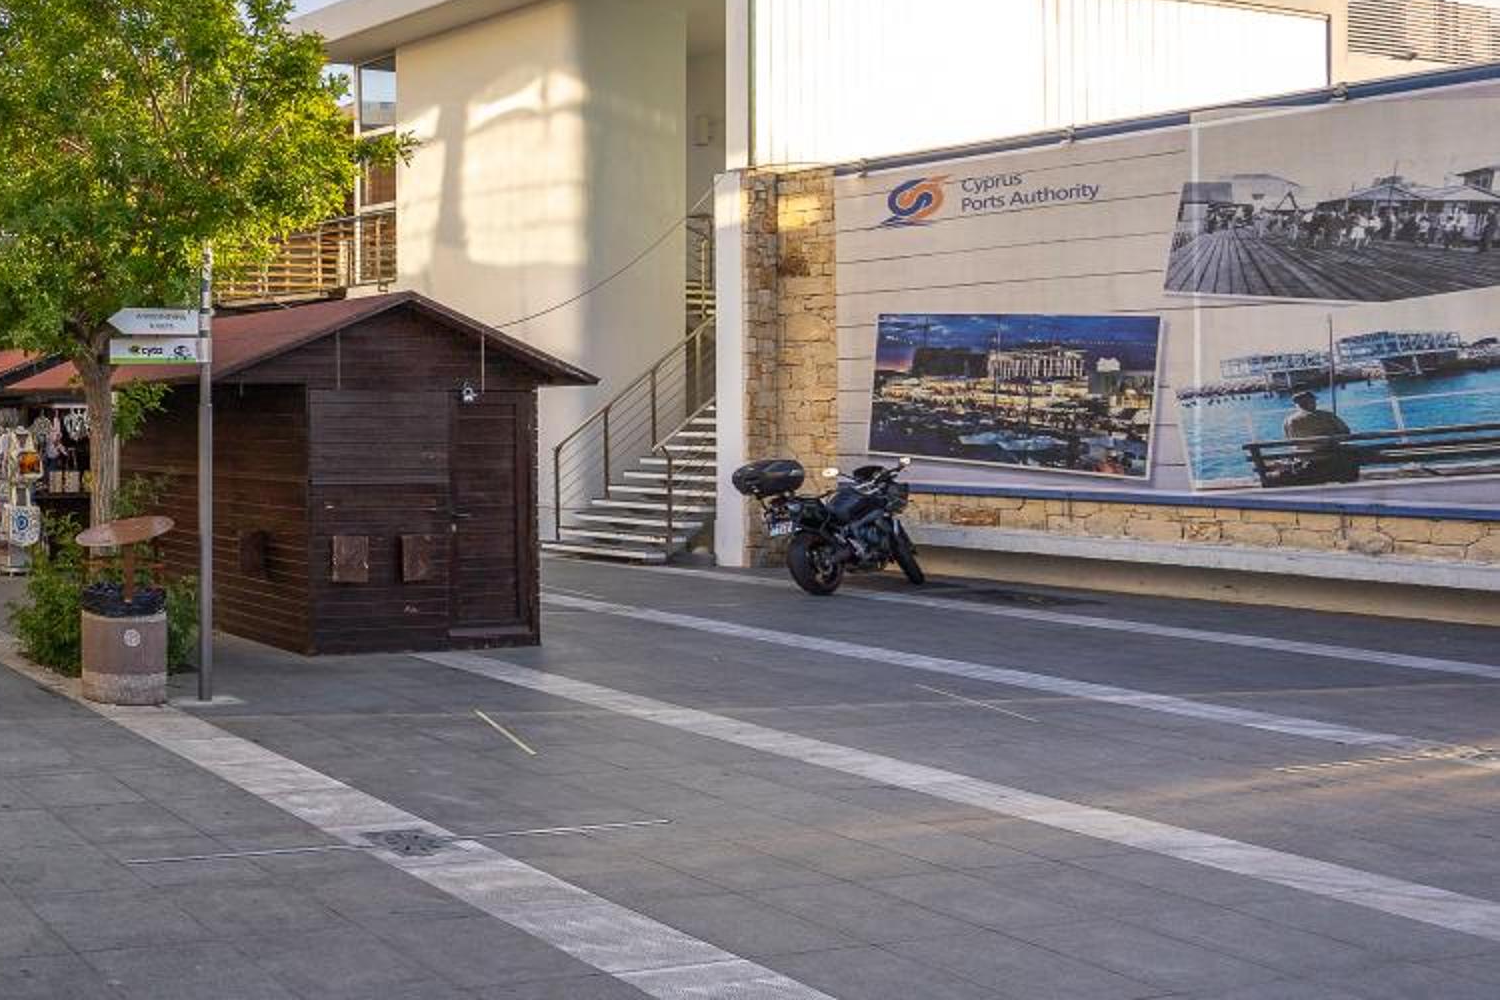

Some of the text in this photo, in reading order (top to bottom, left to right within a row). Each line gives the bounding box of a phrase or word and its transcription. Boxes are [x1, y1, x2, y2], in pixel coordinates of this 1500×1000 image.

[961, 173, 1023, 194] Cyprus
[961, 183, 1100, 212] Ports Authority
